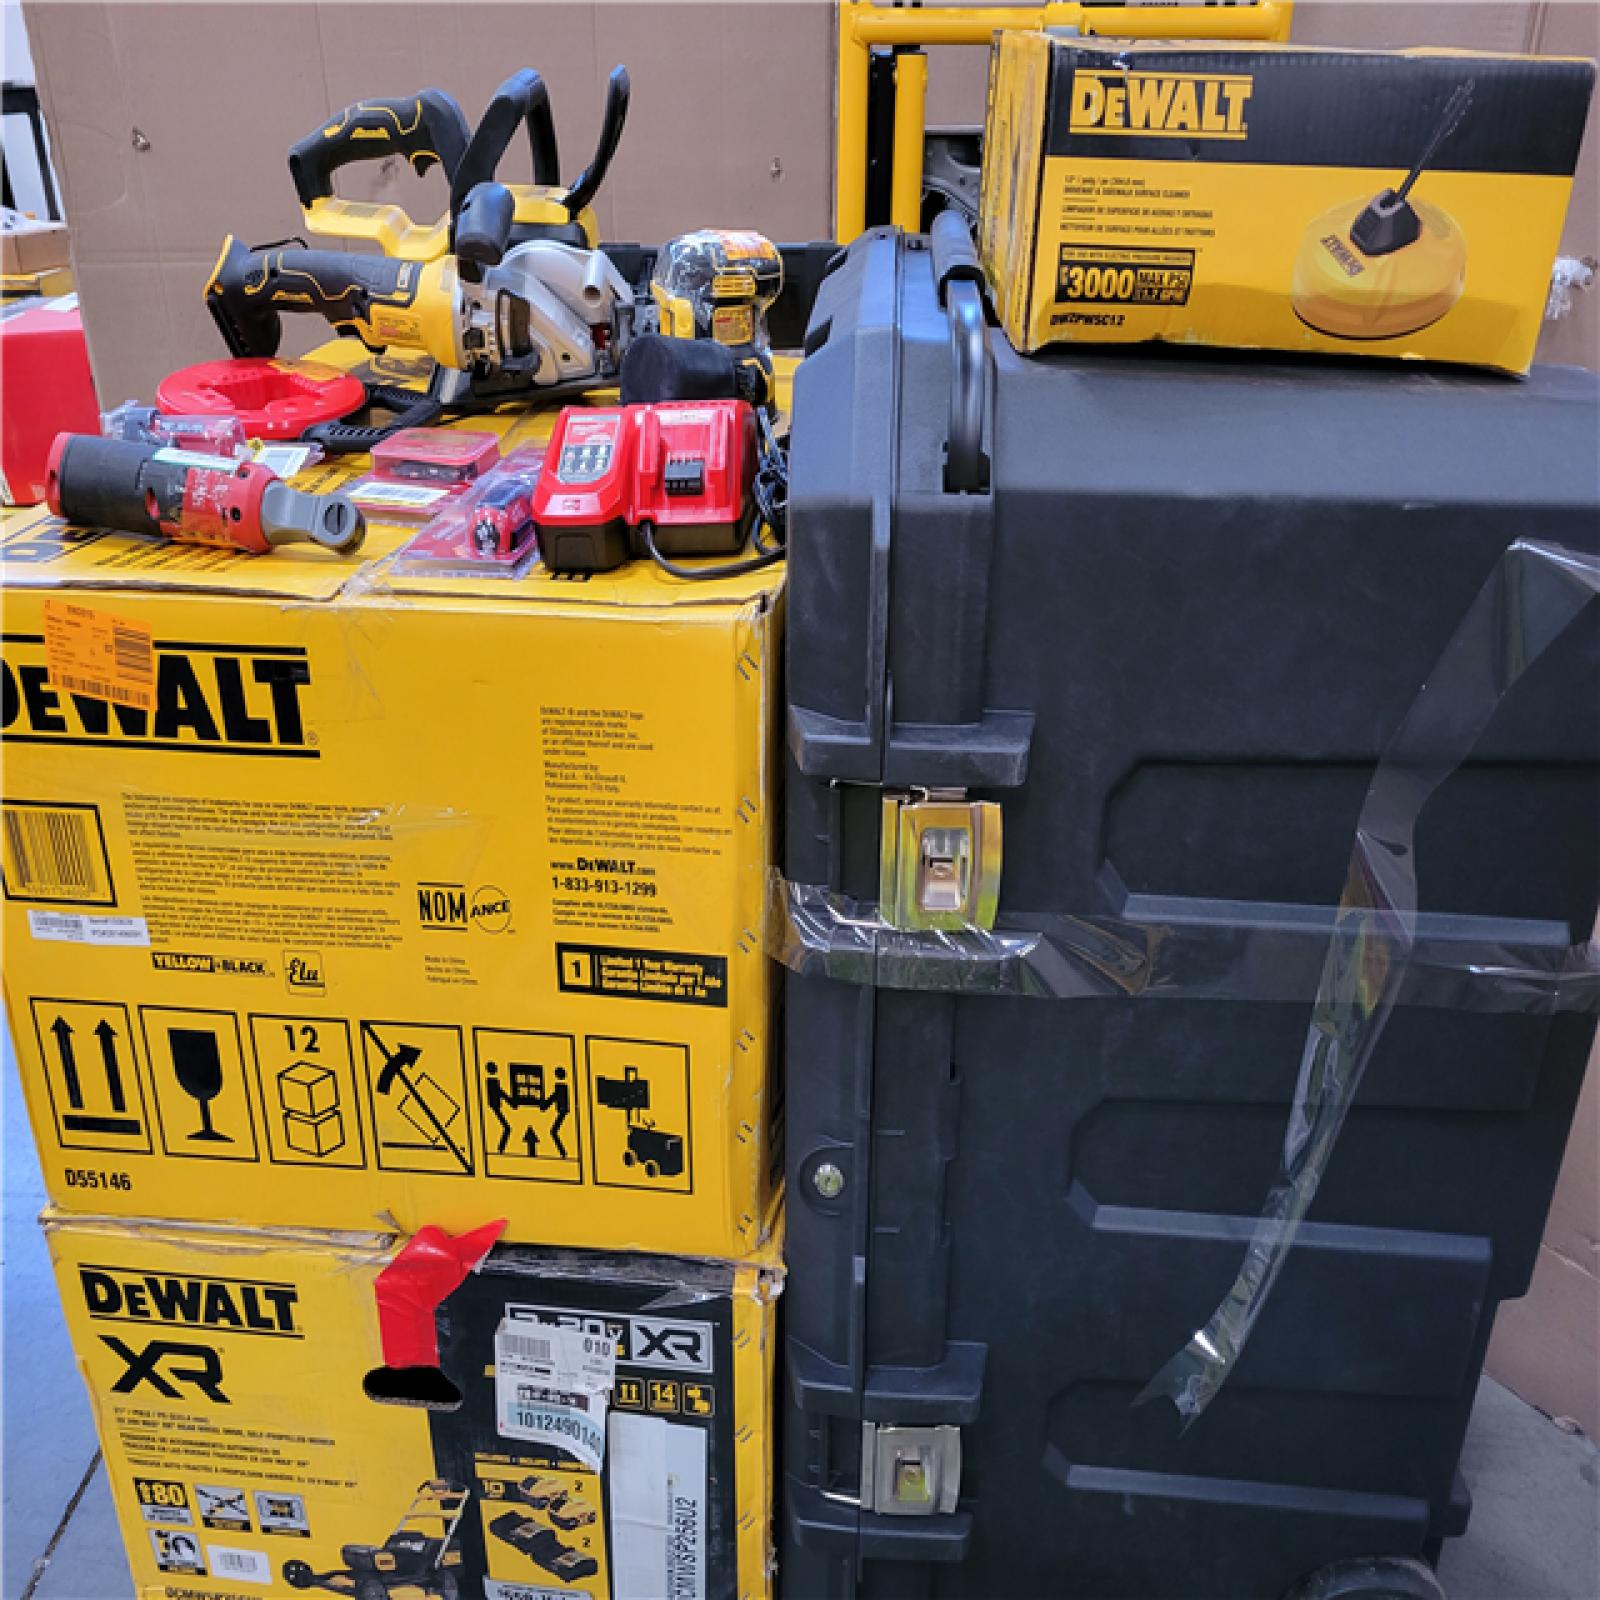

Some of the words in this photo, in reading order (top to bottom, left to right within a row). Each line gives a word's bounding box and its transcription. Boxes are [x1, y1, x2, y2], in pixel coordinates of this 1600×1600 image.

[1071, 76, 1253, 132] DEWALT
[1067, 267, 1135, 299] 3000
[417, 890, 468, 923] NOM
[283, 1024, 321, 1053] 12
[64, 1168, 132, 1191] D55146
[80, 1269, 298, 1332] DEWALT
[636, 1324, 703, 1364] XR
[98, 1334, 233, 1405] XR
